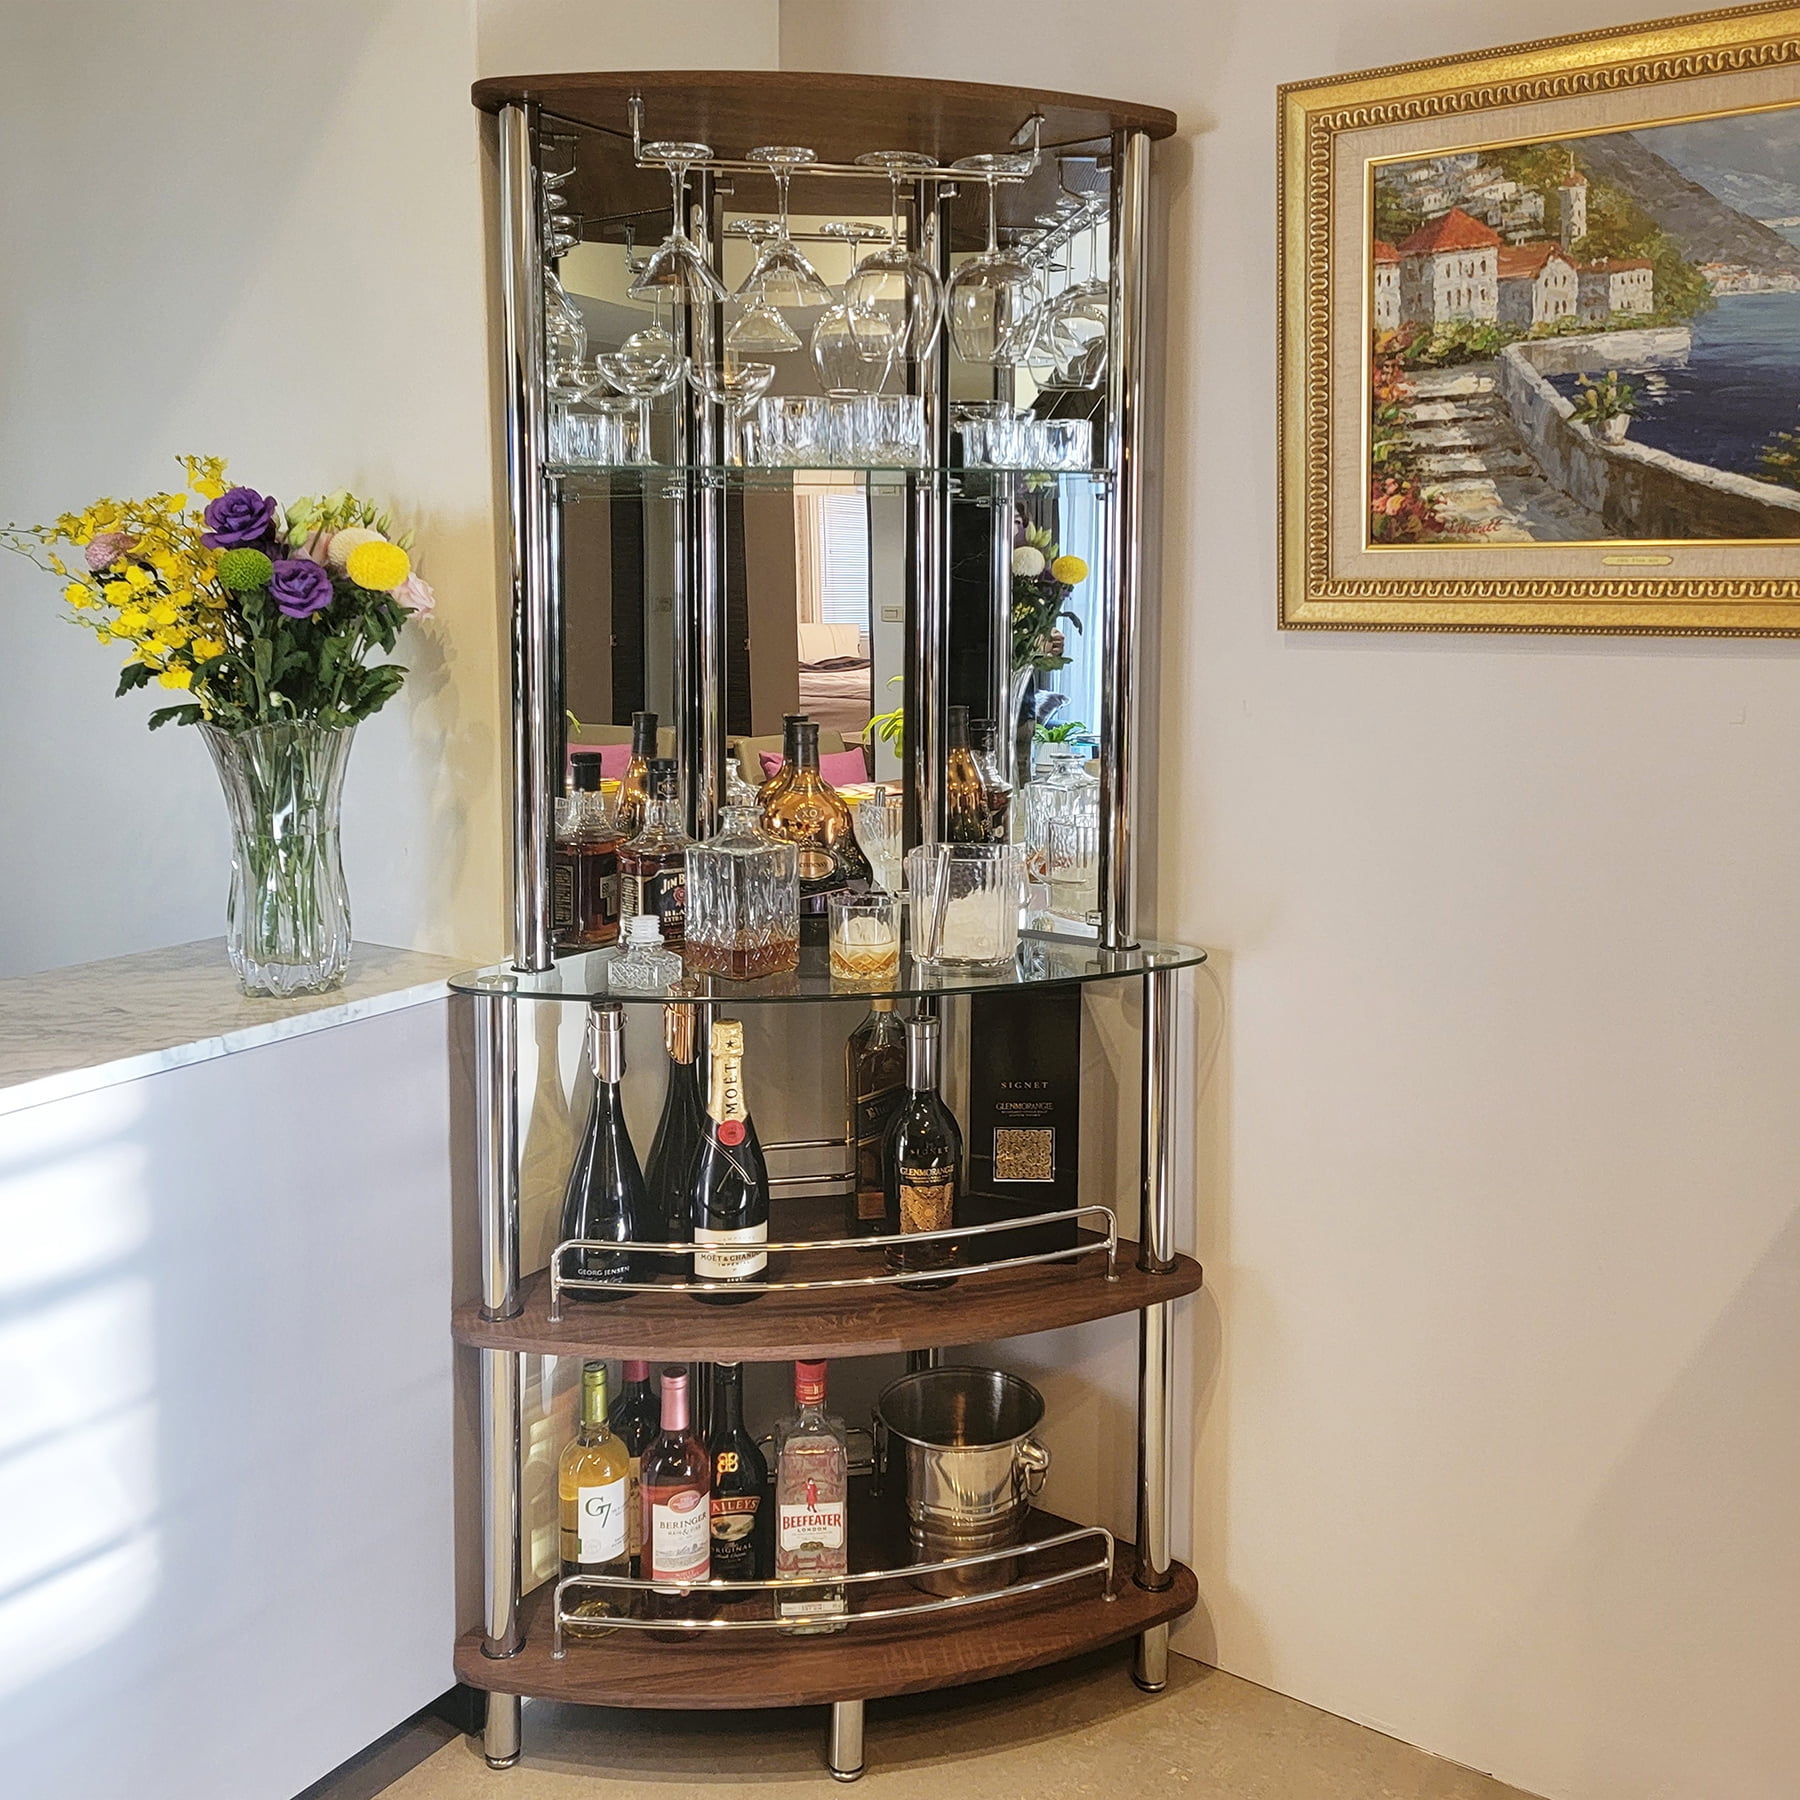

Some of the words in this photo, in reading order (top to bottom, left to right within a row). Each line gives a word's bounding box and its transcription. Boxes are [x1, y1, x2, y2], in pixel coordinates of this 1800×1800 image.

[664, 909, 686, 917] BLA
[1000, 1081, 1049, 1089] SIGNET
[577, 1268, 603, 1276] GEORG
[604, 1265, 631, 1276] JENSEN
[712, 1500, 756, 1512] AILEYS
[585, 1496, 613, 1529] G7
[659, 1511, 707, 1530] BERINGER
[783, 1513, 842, 1530] BEEFEATER
